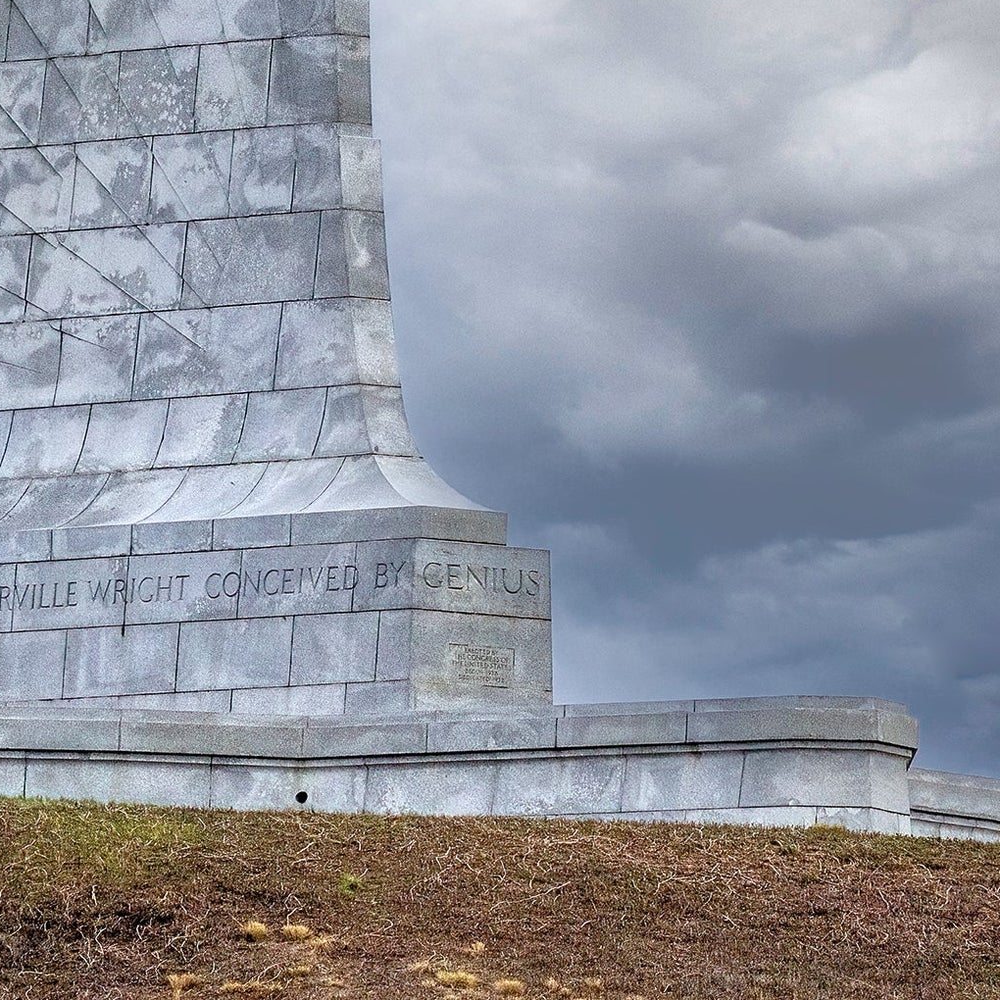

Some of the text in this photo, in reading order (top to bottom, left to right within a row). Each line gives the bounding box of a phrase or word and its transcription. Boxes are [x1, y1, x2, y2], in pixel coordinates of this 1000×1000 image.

[88, 574, 190, 604] WRIGHT
[205, 565, 359, 599] CONCEIVED
[374, 561, 407, 590] BY
[423, 562, 541, 596] GENIUS
[467, 654, 500, 664] CONGRESS
